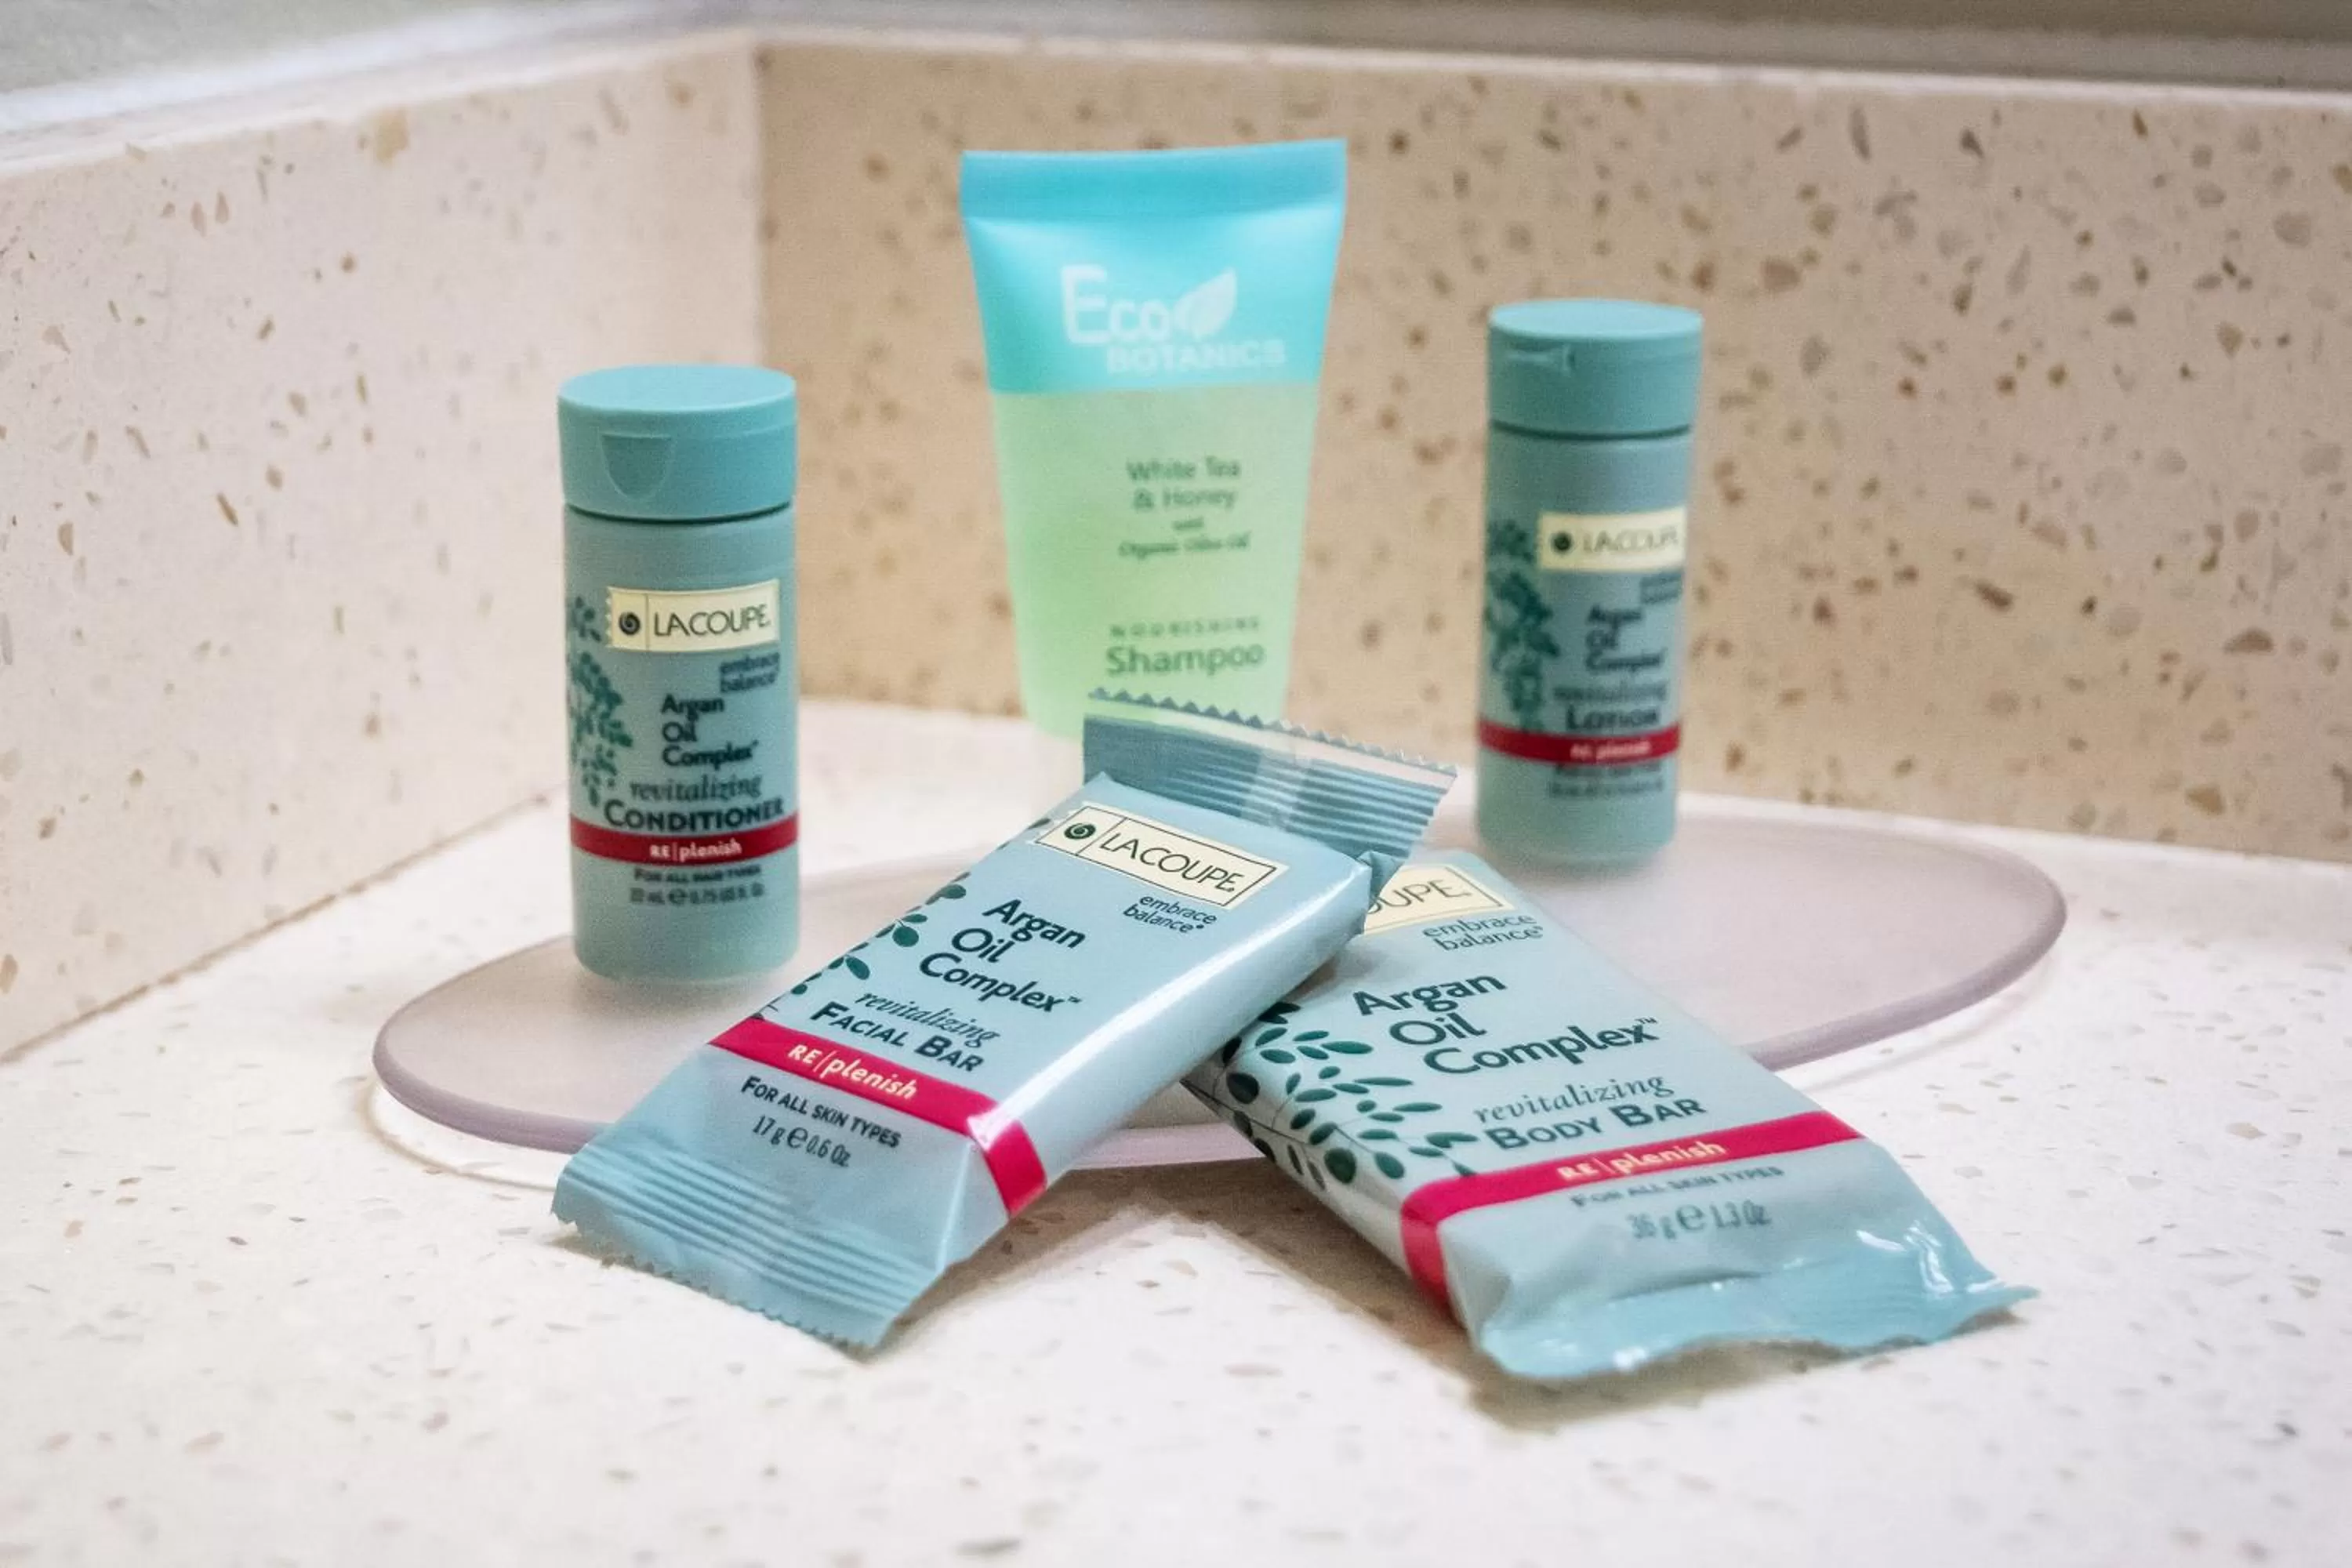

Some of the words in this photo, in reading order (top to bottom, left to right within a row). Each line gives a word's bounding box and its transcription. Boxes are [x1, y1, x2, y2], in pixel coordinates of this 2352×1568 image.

[1106, 339, 1286, 376] BOTANICS
[1126, 459, 1196, 481] White
[1205, 456, 1241, 478] Tea
[1133, 487, 1153, 510] &
[1163, 488, 1237, 511] Honey
[1119, 541, 1178, 559] Organic
[654, 604, 771, 637] LACOUPE
[1110, 616, 1260, 637] NOURISHING
[1105, 644, 1267, 677] Shampoo
[662, 695, 724, 723] Argan
[1566, 704, 1660, 731] LOTION
[662, 721, 698, 742] Oil
[630, 774, 763, 801] revitalizing
[604, 798, 783, 833] CONDITIONER
[1100, 833, 1243, 892] LACOUPE
[982, 898, 1087, 949] Argan
[1139, 895, 1218, 924] embrace
[1423, 913, 1538, 938] embrace
[951, 927, 1016, 963] Oil
[1352, 975, 1508, 1016] Argan
[810, 1000, 909, 1047] FACIAL
[913, 1034, 985, 1072] BAR
[855, 993, 1000, 1048] revitalizing
[1388, 1011, 1487, 1046] Oil
[741, 1075, 779, 1103] FOR
[780, 1093, 808, 1115] ALL
[811, 1104, 850, 1128] SKIN
[850, 1115, 902, 1149] TYPES
[1472, 1076, 1675, 1124] revitalizing
[1484, 1116, 1605, 1151] BODY
[1608, 1098, 1708, 1128] BAR
[1570, 1189, 1624, 1208] FOR
[1627, 1182, 1666, 1197] ALL
[1667, 1174, 1718, 1190] SKIN
[1717, 1164, 1786, 1183] TYPES
